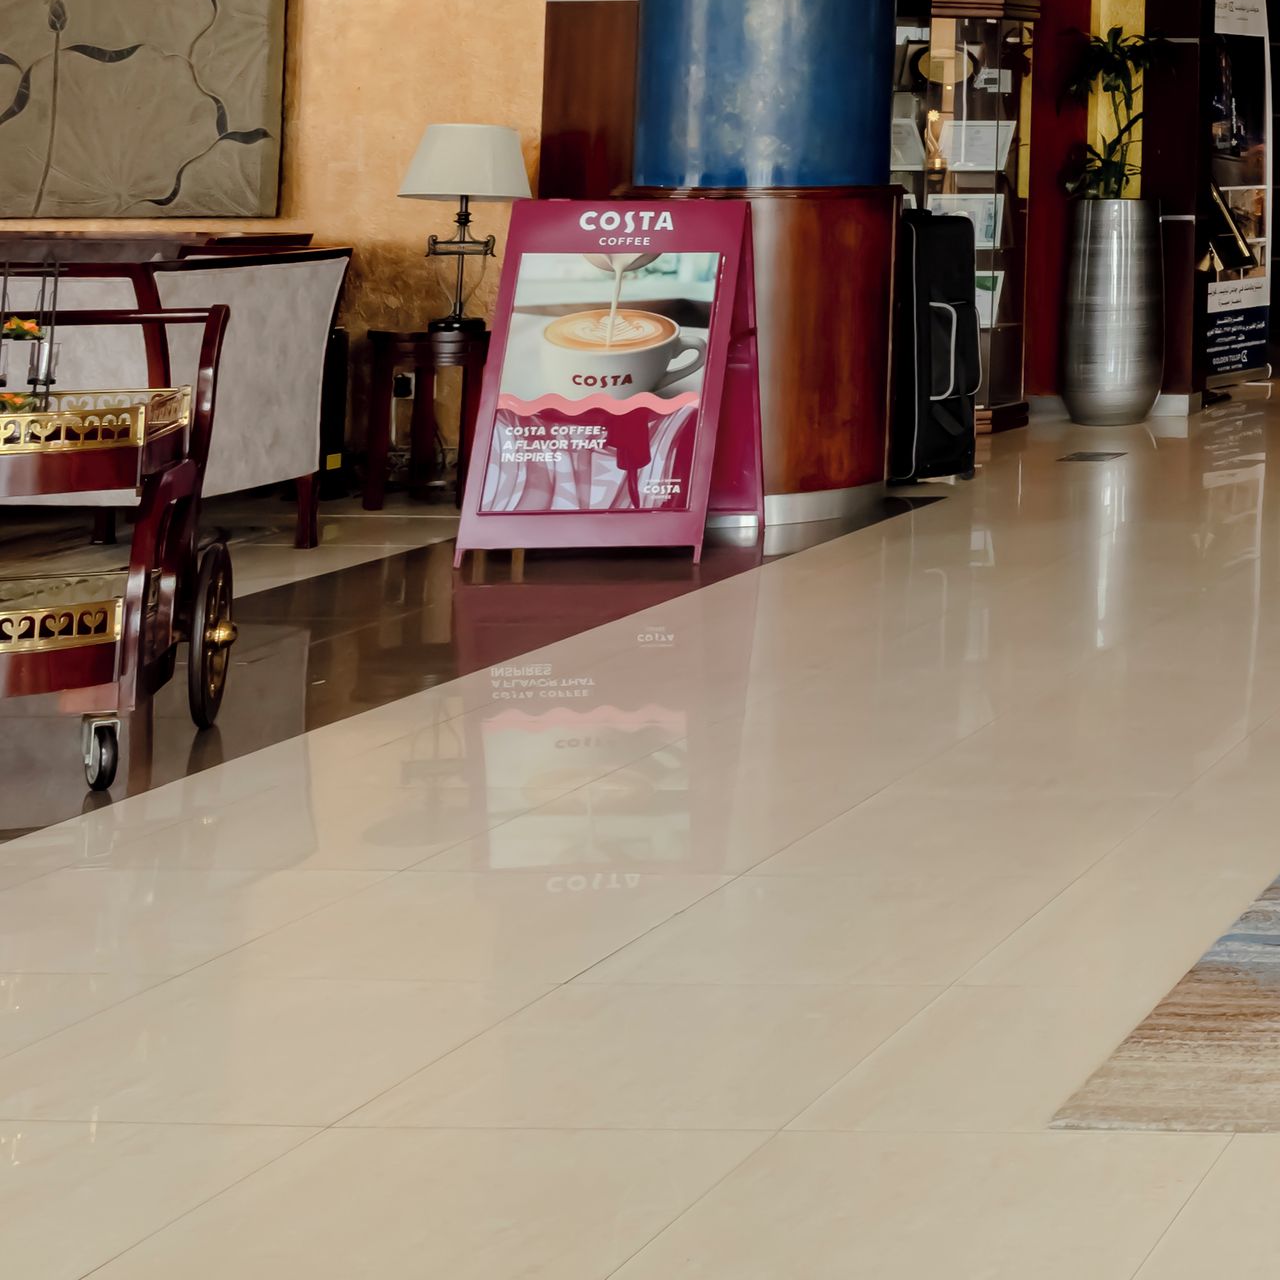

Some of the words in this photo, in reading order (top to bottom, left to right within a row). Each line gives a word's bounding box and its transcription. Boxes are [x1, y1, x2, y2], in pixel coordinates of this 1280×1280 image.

[579, 210, 674, 234] COSTA
[598, 237, 651, 246] COFFEE
[572, 373, 633, 389] COSTA
[505, 426, 547, 437] COSTA
[550, 425, 607, 435] COFFEE:
[502, 440, 514, 450] A
[514, 439, 569, 450] FLAVOR
[570, 439, 607, 449] THAT
[501, 452, 563, 462] INSPIRES
[643, 484, 681, 494] COSTA
